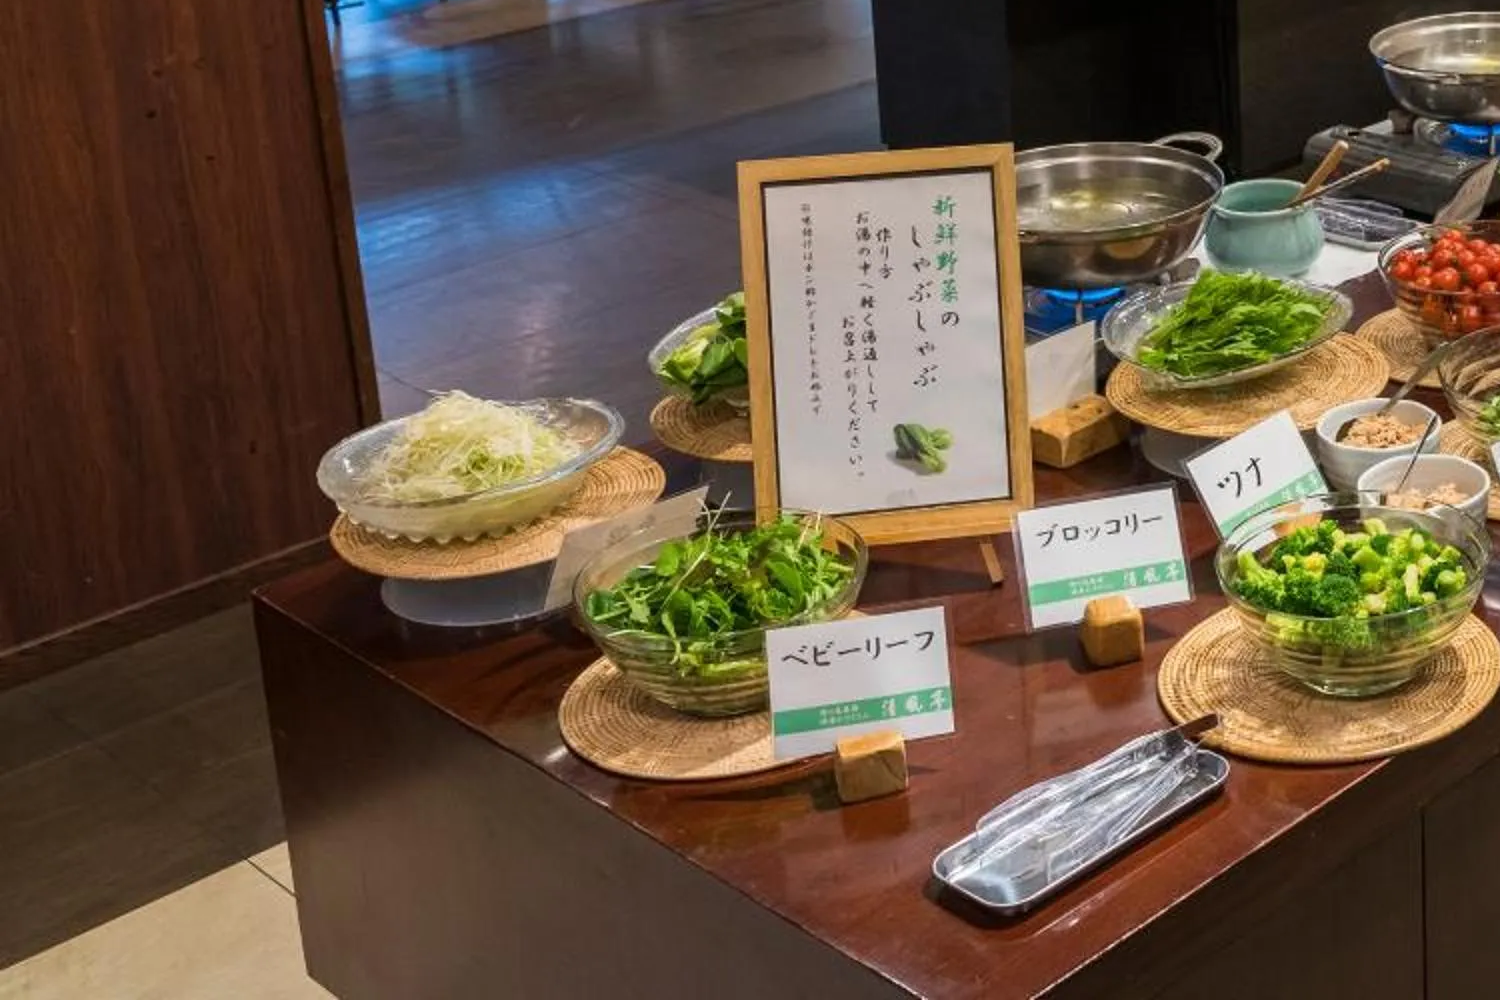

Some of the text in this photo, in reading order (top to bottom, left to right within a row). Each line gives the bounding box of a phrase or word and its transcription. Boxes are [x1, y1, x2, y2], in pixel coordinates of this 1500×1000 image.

[875, 228, 896, 279] 作り方
[931, 194, 960, 328] 新鮮野菜の
[908, 223, 941, 389] しゃぶしゃぶ
[1216, 455, 1264, 499] ツナ
[1036, 512, 1164, 549] ブロッコリー
[781, 630, 935, 667] ベビーリーフ
